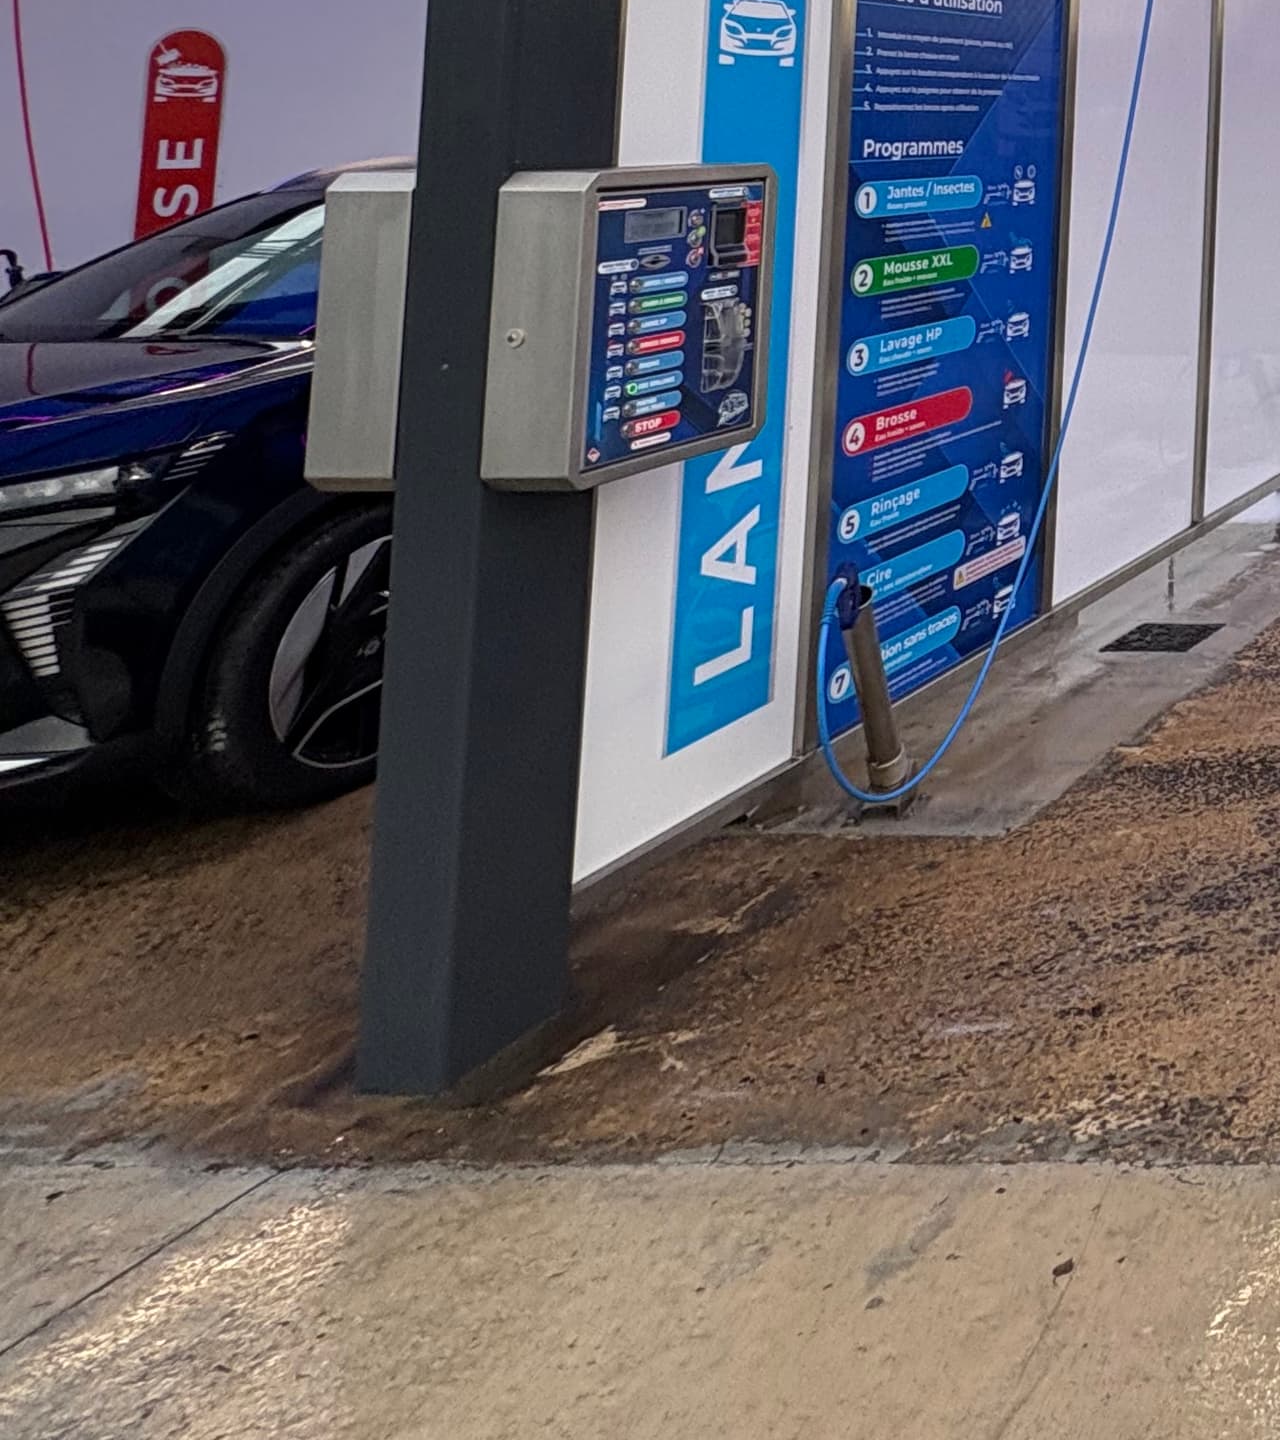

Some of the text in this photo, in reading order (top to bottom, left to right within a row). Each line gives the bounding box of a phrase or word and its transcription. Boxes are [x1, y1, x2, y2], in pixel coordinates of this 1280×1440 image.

[863, 139, 964, 160] Programmes
[864, 191, 870, 210] 1
[887, 186, 925, 200] Jantes
[933, 182, 975, 195] Insectes
[858, 253, 953, 288] 2 Mousse XXL
[854, 348, 864, 367] 3
[880, 334, 923, 358] Lavage
[926, 327, 943, 342] HP
[634, 417, 663, 433] STOP
[849, 428, 860, 446] 4
[876, 409, 917, 431] Brosse
[845, 515, 855, 535] 5
[871, 487, 921, 516] Rinçage
[693, 441, 763, 687] LAN
[867, 568, 892, 586] Cire
[903, 629, 928, 649] sans
[927, 612, 958, 635] traces
[836, 673, 846, 695] 7
